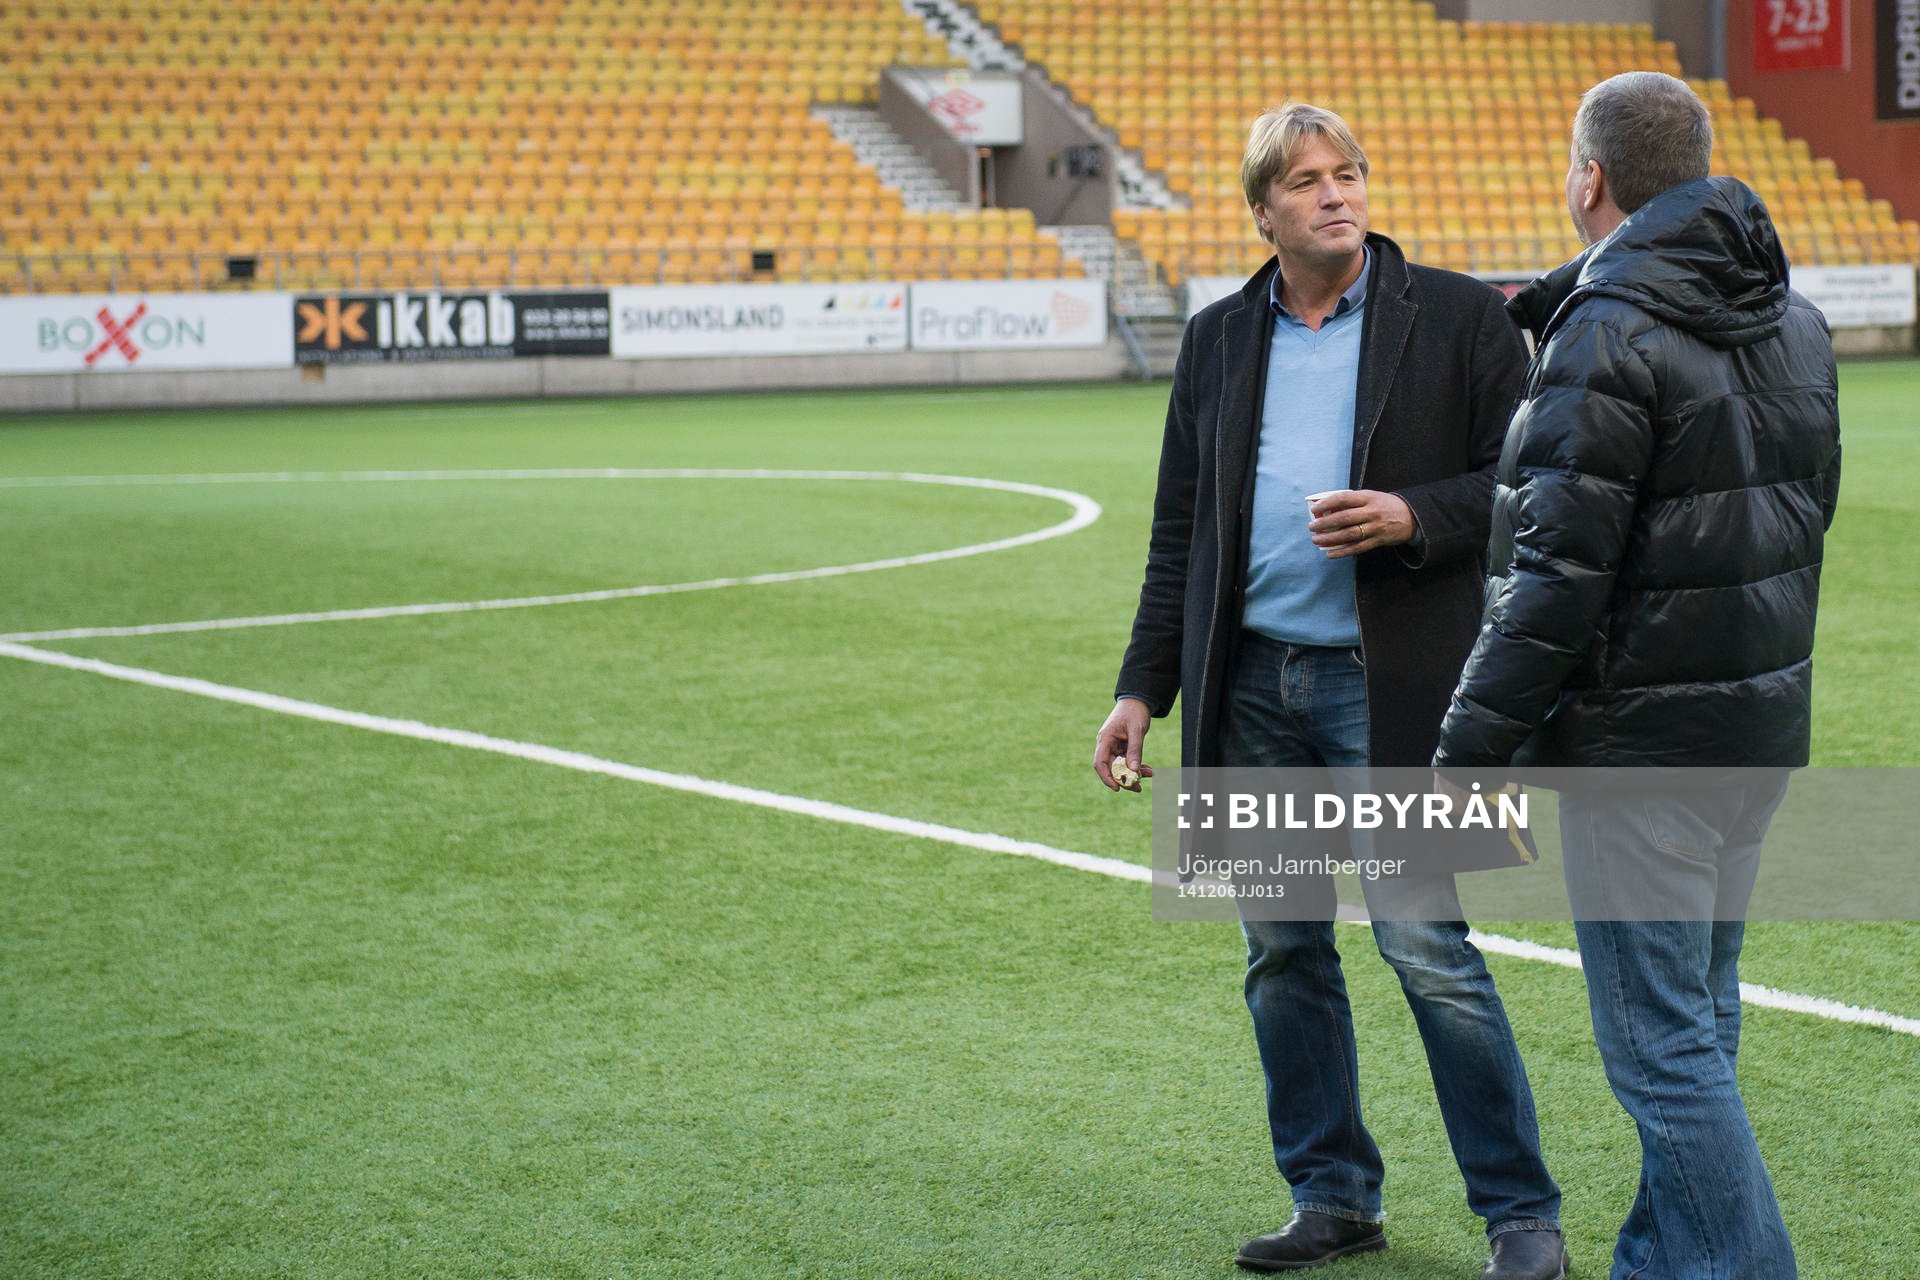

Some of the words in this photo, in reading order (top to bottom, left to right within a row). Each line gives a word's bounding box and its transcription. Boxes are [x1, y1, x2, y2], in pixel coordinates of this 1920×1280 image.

[38, 303, 206, 368] BOXON
[376, 292, 516, 349] ikkab
[620, 304, 785, 333] SIMONSLAND
